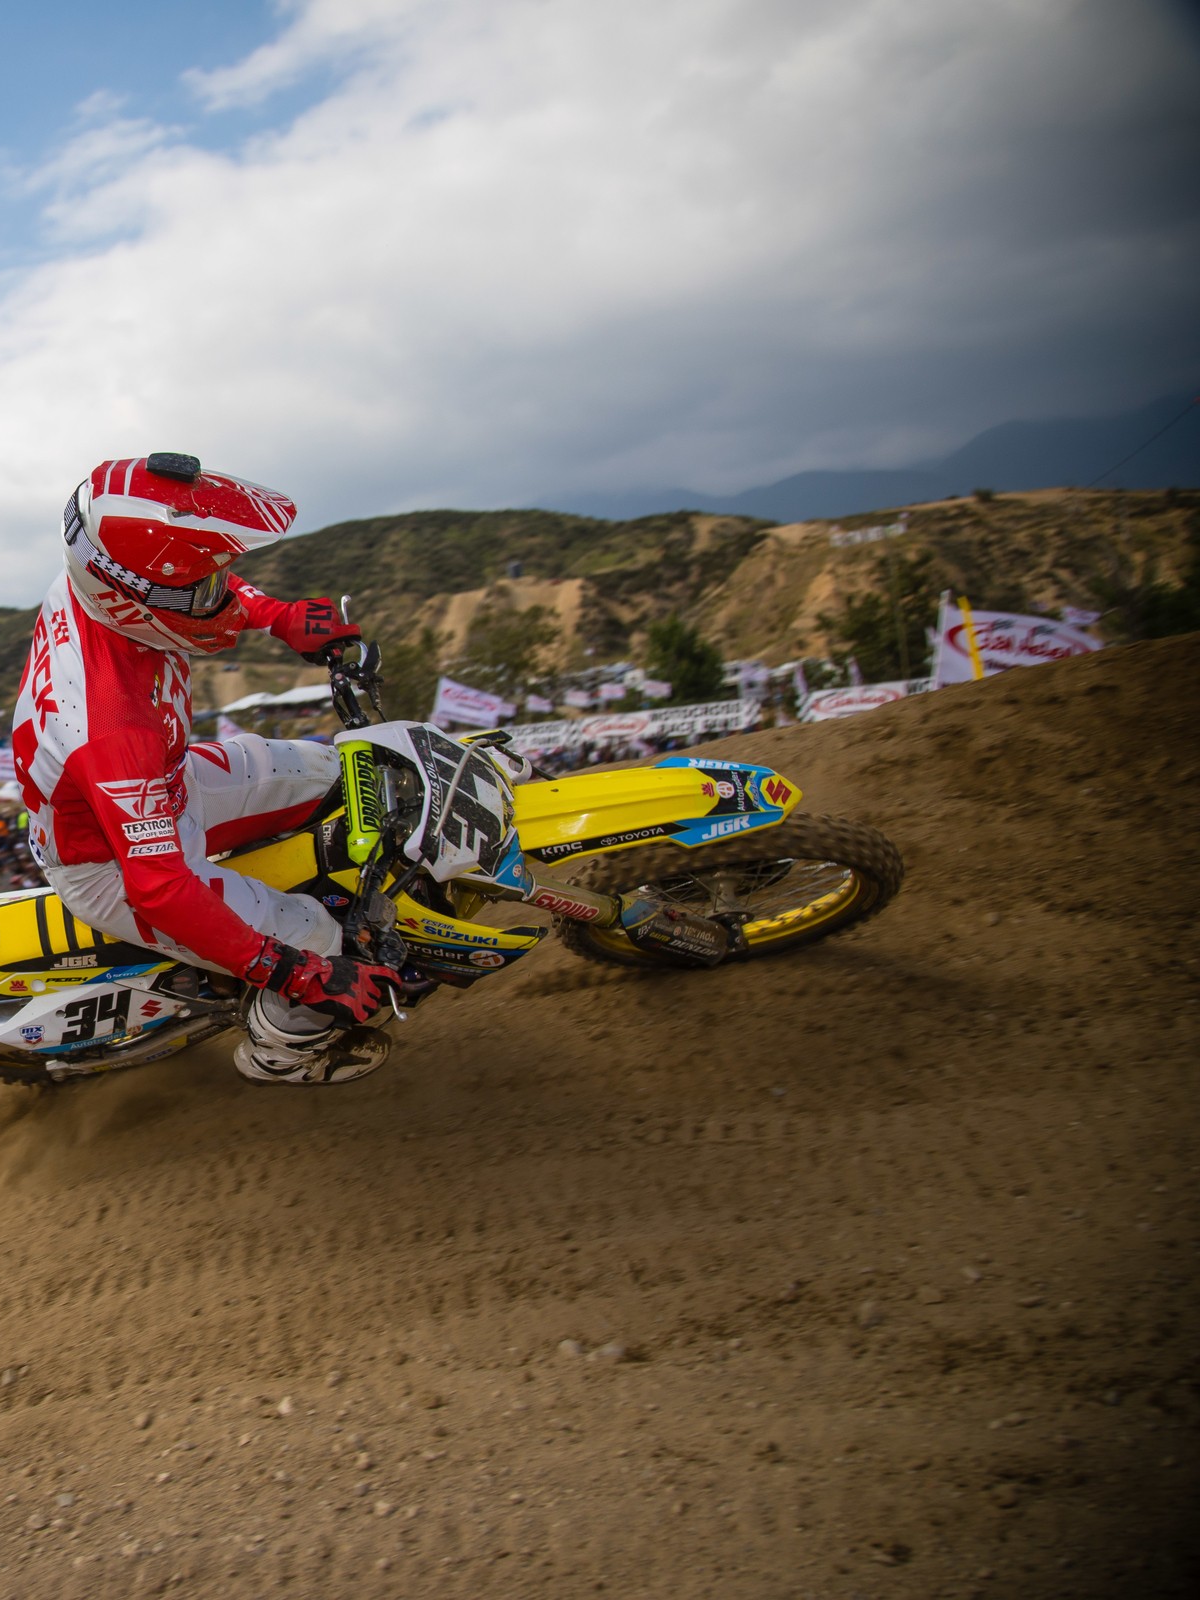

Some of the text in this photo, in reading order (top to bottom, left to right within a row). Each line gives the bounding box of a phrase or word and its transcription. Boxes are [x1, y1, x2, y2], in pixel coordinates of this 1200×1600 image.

[97, 589, 146, 627] FLY
[305, 601, 332, 636] FLY
[424, 761, 441, 822] LUCAS OIL
[124, 818, 173, 835] TEXTRON
[618, 827, 665, 842] TOYOTA
[702, 815, 750, 840] JGR
[131, 842, 174, 855] ECSTAR
[420, 918, 456, 930] ECSTAR
[423, 925, 498, 946] SUZUKI
[53, 954, 98, 968] JGR
[60, 988, 132, 1045] 34
[70, 1032, 124, 1050] Autotrader
